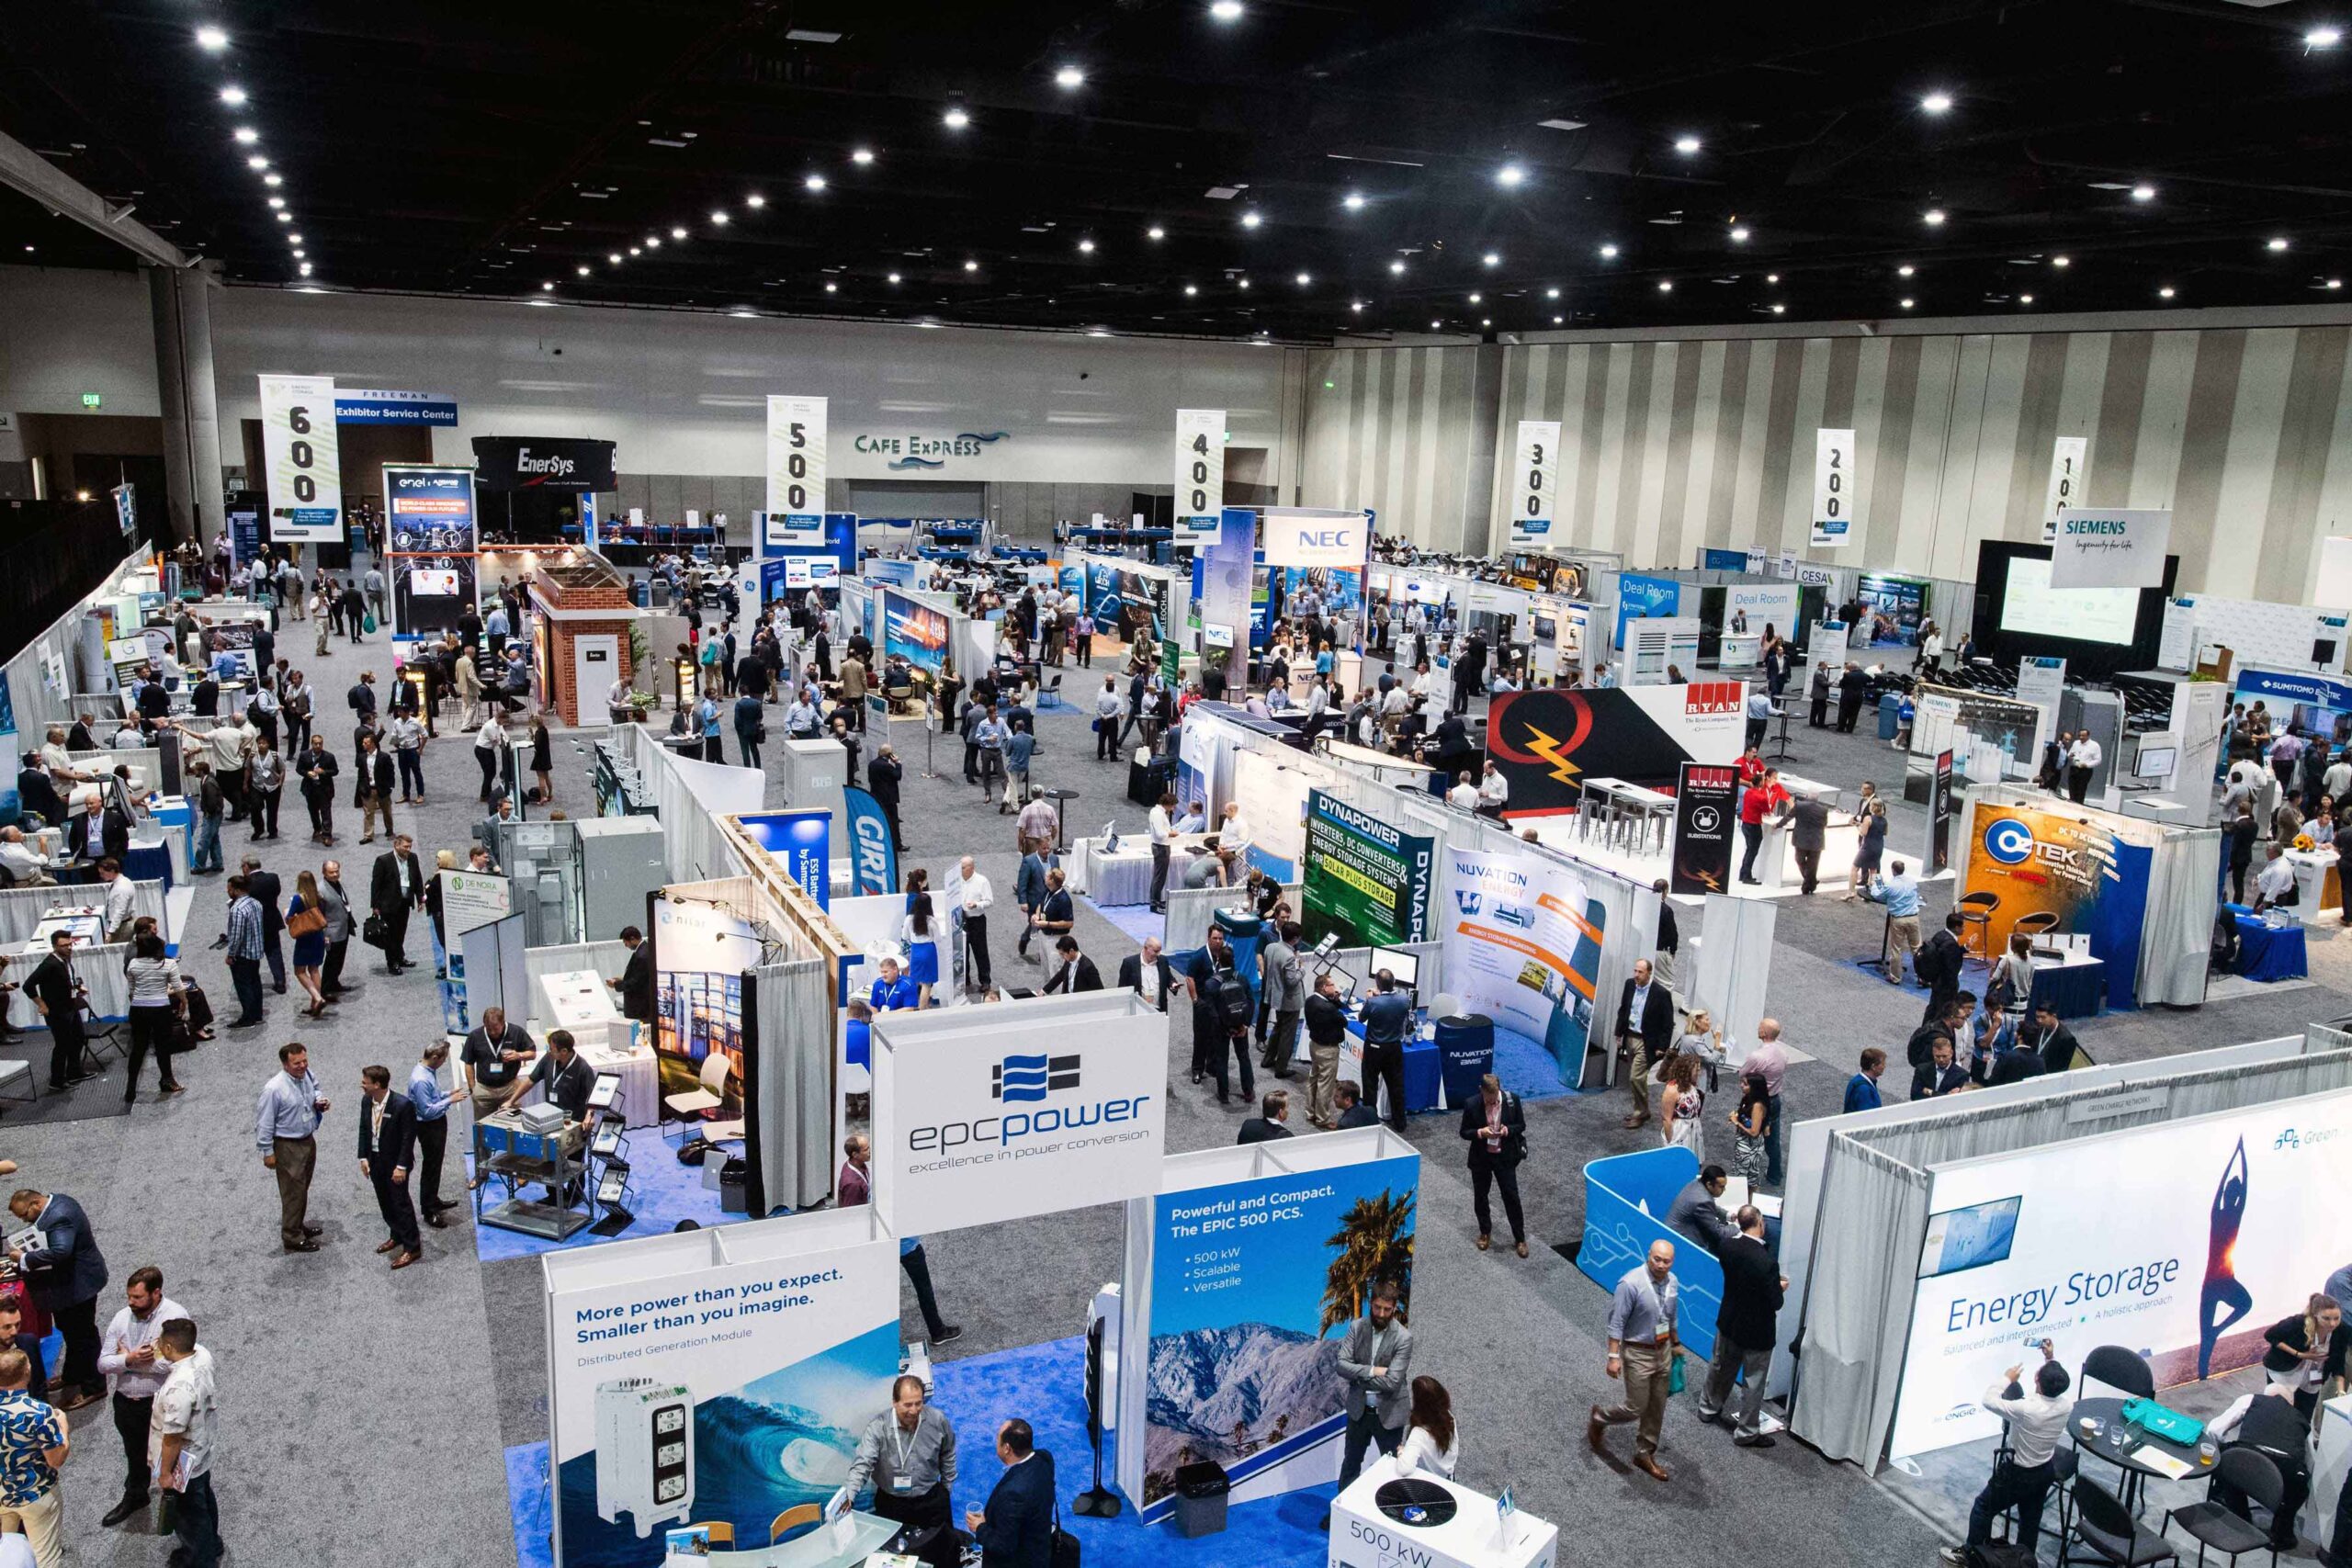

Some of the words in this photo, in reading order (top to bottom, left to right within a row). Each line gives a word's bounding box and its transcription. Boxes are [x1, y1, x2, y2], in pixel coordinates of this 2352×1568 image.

[83, 394, 100, 406] EXIT
[336, 408, 380, 417] Exhibitor
[383, 409, 419, 418] Service
[423, 411, 454, 420] Center
[854, 434, 899, 454] CAFE
[289, 407, 315, 502] 600
[517, 448, 573, 476] EnerSys
[788, 423, 806, 509] 500
[1193, 434, 1208, 512] 400
[1527, 445, 1544, 516] 300
[1827, 449, 1841, 517] 200
[2066, 521, 2126, 535] SIEMENS
[1299, 531, 1350, 547] NEC
[2075, 539, 2109, 553] Ingenuity
[2109, 541, 2120, 550] for
[2121, 540, 2132, 549] life
[1802, 570, 1827, 583] CESA
[1623, 580, 1645, 595] Deal
[1646, 582, 1674, 600] Room
[1736, 593, 1757, 604] Deal
[1759, 594, 1787, 604] Room
[1208, 630, 1229, 640] NEC
[2272, 682, 2314, 694] SUMITOMO
[1687, 701, 1740, 713] RYAN
[1688, 780, 1731, 788] RYAN
[1319, 795, 1400, 847] DYNAPOWER
[799, 849, 808, 859] by
[1310, 818, 1345, 845] INVERTERS,
[1346, 838, 1355, 849] DC
[1356, 842, 1400, 873] CONVERTERS
[1399, 864, 1408, 886] &
[1312, 835, 1337, 857] ENERGY
[1337, 848, 1365, 871] STORAGE
[1366, 864, 1397, 889] SYSTEMS
[809, 859, 819, 874] ESS
[1455, 863, 1528, 886] NUVATION
[2035, 857, 2064, 870] Innovative
[2066, 864, 2086, 877] Thinking
[466, 879, 475, 887] DE
[478, 881, 497, 889] NORA
[799, 861, 808, 896] Samsun
[1311, 852, 1324, 865] FOR
[1324, 856, 1344, 877] SOLAR
[1345, 868, 1363, 886] PLUS
[1363, 876, 1394, 905] STORAGE
[2061, 870, 2076, 881] Power
[2077, 875, 2093, 886] Control
[1481, 880, 1525, 898] ENERGY
[1468, 927, 1487, 938] ENERGY
[1487, 932, 1508, 943] STORAGE
[1509, 939, 1537, 954] ENGINEERING
[1450, 1047, 1493, 1058] NUVATION
[2105, 1102, 2124, 1111] CHARGE
[2125, 1096, 2151, 1107] NETWORKS
[910, 1097, 1150, 1155] epcpower
[2304, 1128, 2337, 1144] Green
[910, 1152, 993, 1174] excellence
[998, 1150, 1011, 1160] in
[1015, 1143, 1063, 1159] power
[1067, 1130, 1149, 1150] conversion
[1171, 1199, 1235, 1221] Powerful
[1239, 1195, 1265, 1211] and
[1270, 1185, 1335, 1205] Compact.
[1171, 1224, 1198, 1238] The
[1203, 1218, 1235, 1234] EPIC
[1239, 1213, 1268, 1227] 500
[1272, 1207, 1304, 1222] PCS.
[1194, 1251, 1218, 1265] 500
[1221, 1247, 1241, 1258] kW
[1193, 1262, 1240, 1279] Scalable
[1193, 1276, 1241, 1293] Versatile
[1947, 1285, 2058, 1332] Energy
[2065, 1257, 2179, 1306] Storage
[577, 1303, 624, 1323] More
[630, 1292, 688, 1316] power
[694, 1286, 735, 1305] than
[741, 1279, 773, 1298] you
[778, 1267, 843, 1290] expect.
[577, 1322, 648, 1343] Smaller
[654, 1312, 695, 1331] than
[700, 1305, 733, 1325] you
[739, 1292, 814, 1317] imagine.
[1943, 1339, 1984, 1357] Balanced
[1987, 1335, 2005, 1347] and
[2007, 1318, 2072, 1341] interconnected
[2095, 1311, 2101, 1320] A
[2102, 1303, 2132, 1318] holistic
[2134, 1295, 2173, 1314] approach
[577, 1348, 642, 1367] Distributed
[645, 1338, 708, 1356] Generation
[711, 1327, 752, 1343] Module
[1351, 1520, 1390, 1551] 500
[1398, 1541, 1432, 1567] kW
